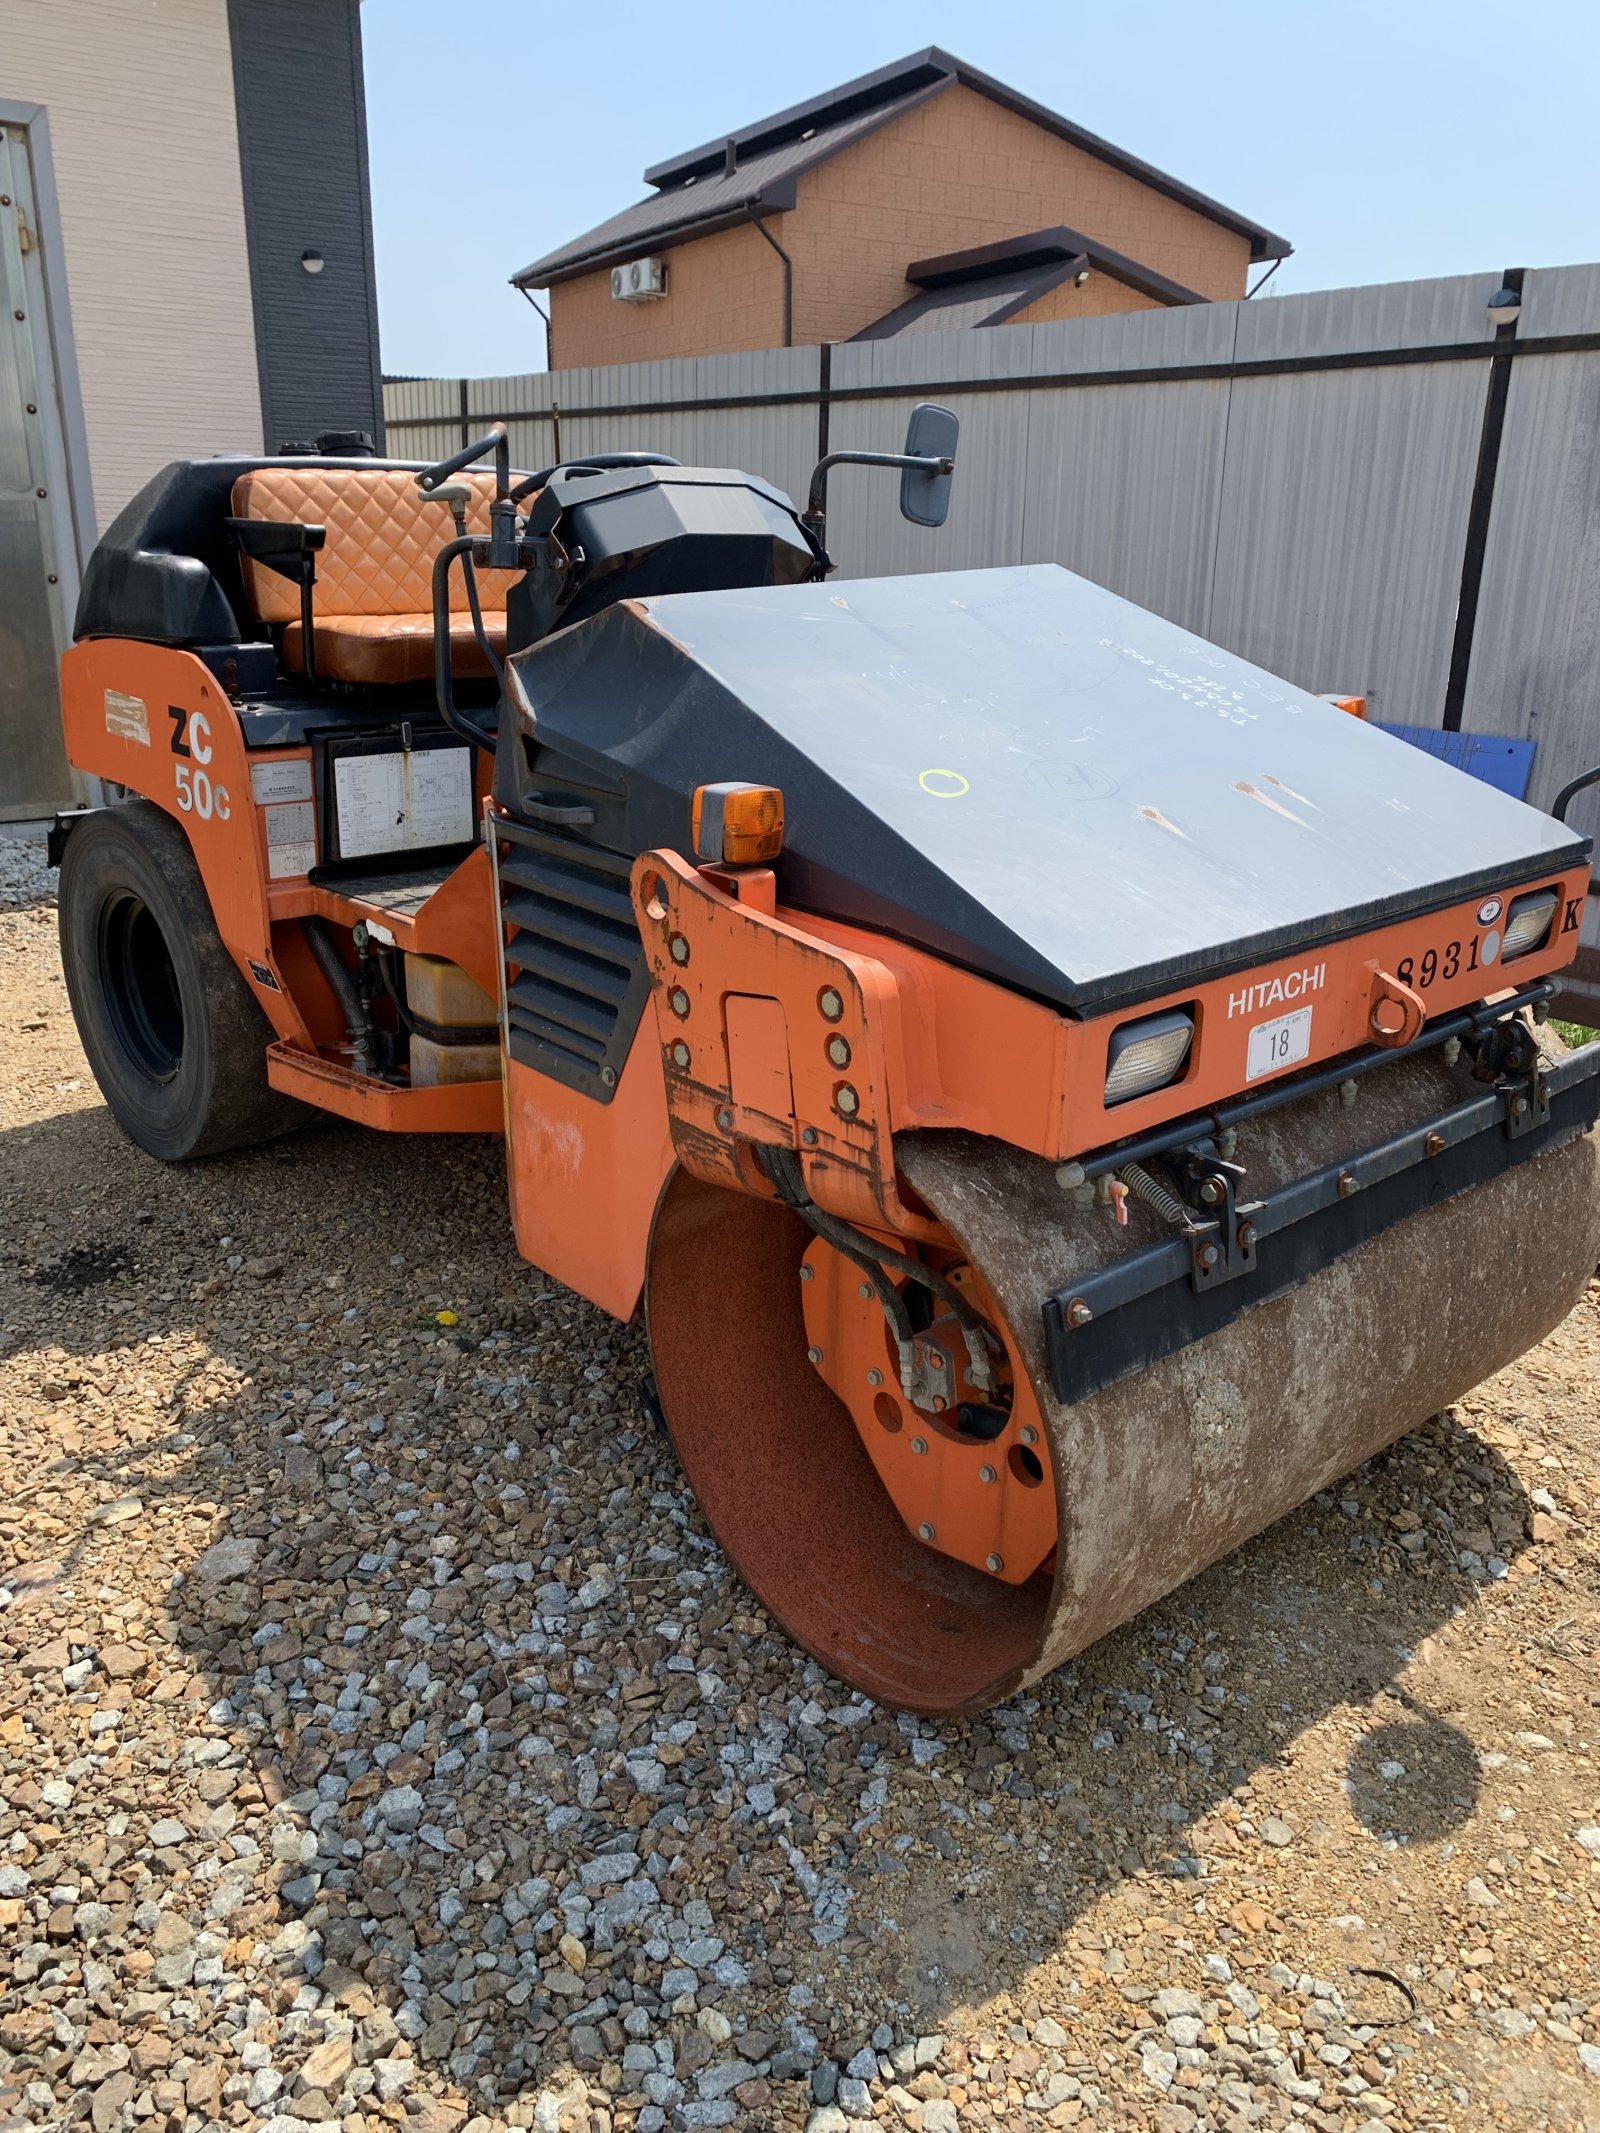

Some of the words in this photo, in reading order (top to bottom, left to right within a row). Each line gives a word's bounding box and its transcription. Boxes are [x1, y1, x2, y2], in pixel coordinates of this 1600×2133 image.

[168, 705, 213, 765] ZC
[1560, 896, 1584, 934] K
[1397, 934, 1480, 988] 8931
[1227, 963, 1326, 1019] HITACHI
[1270, 1028, 1290, 1061] 18
